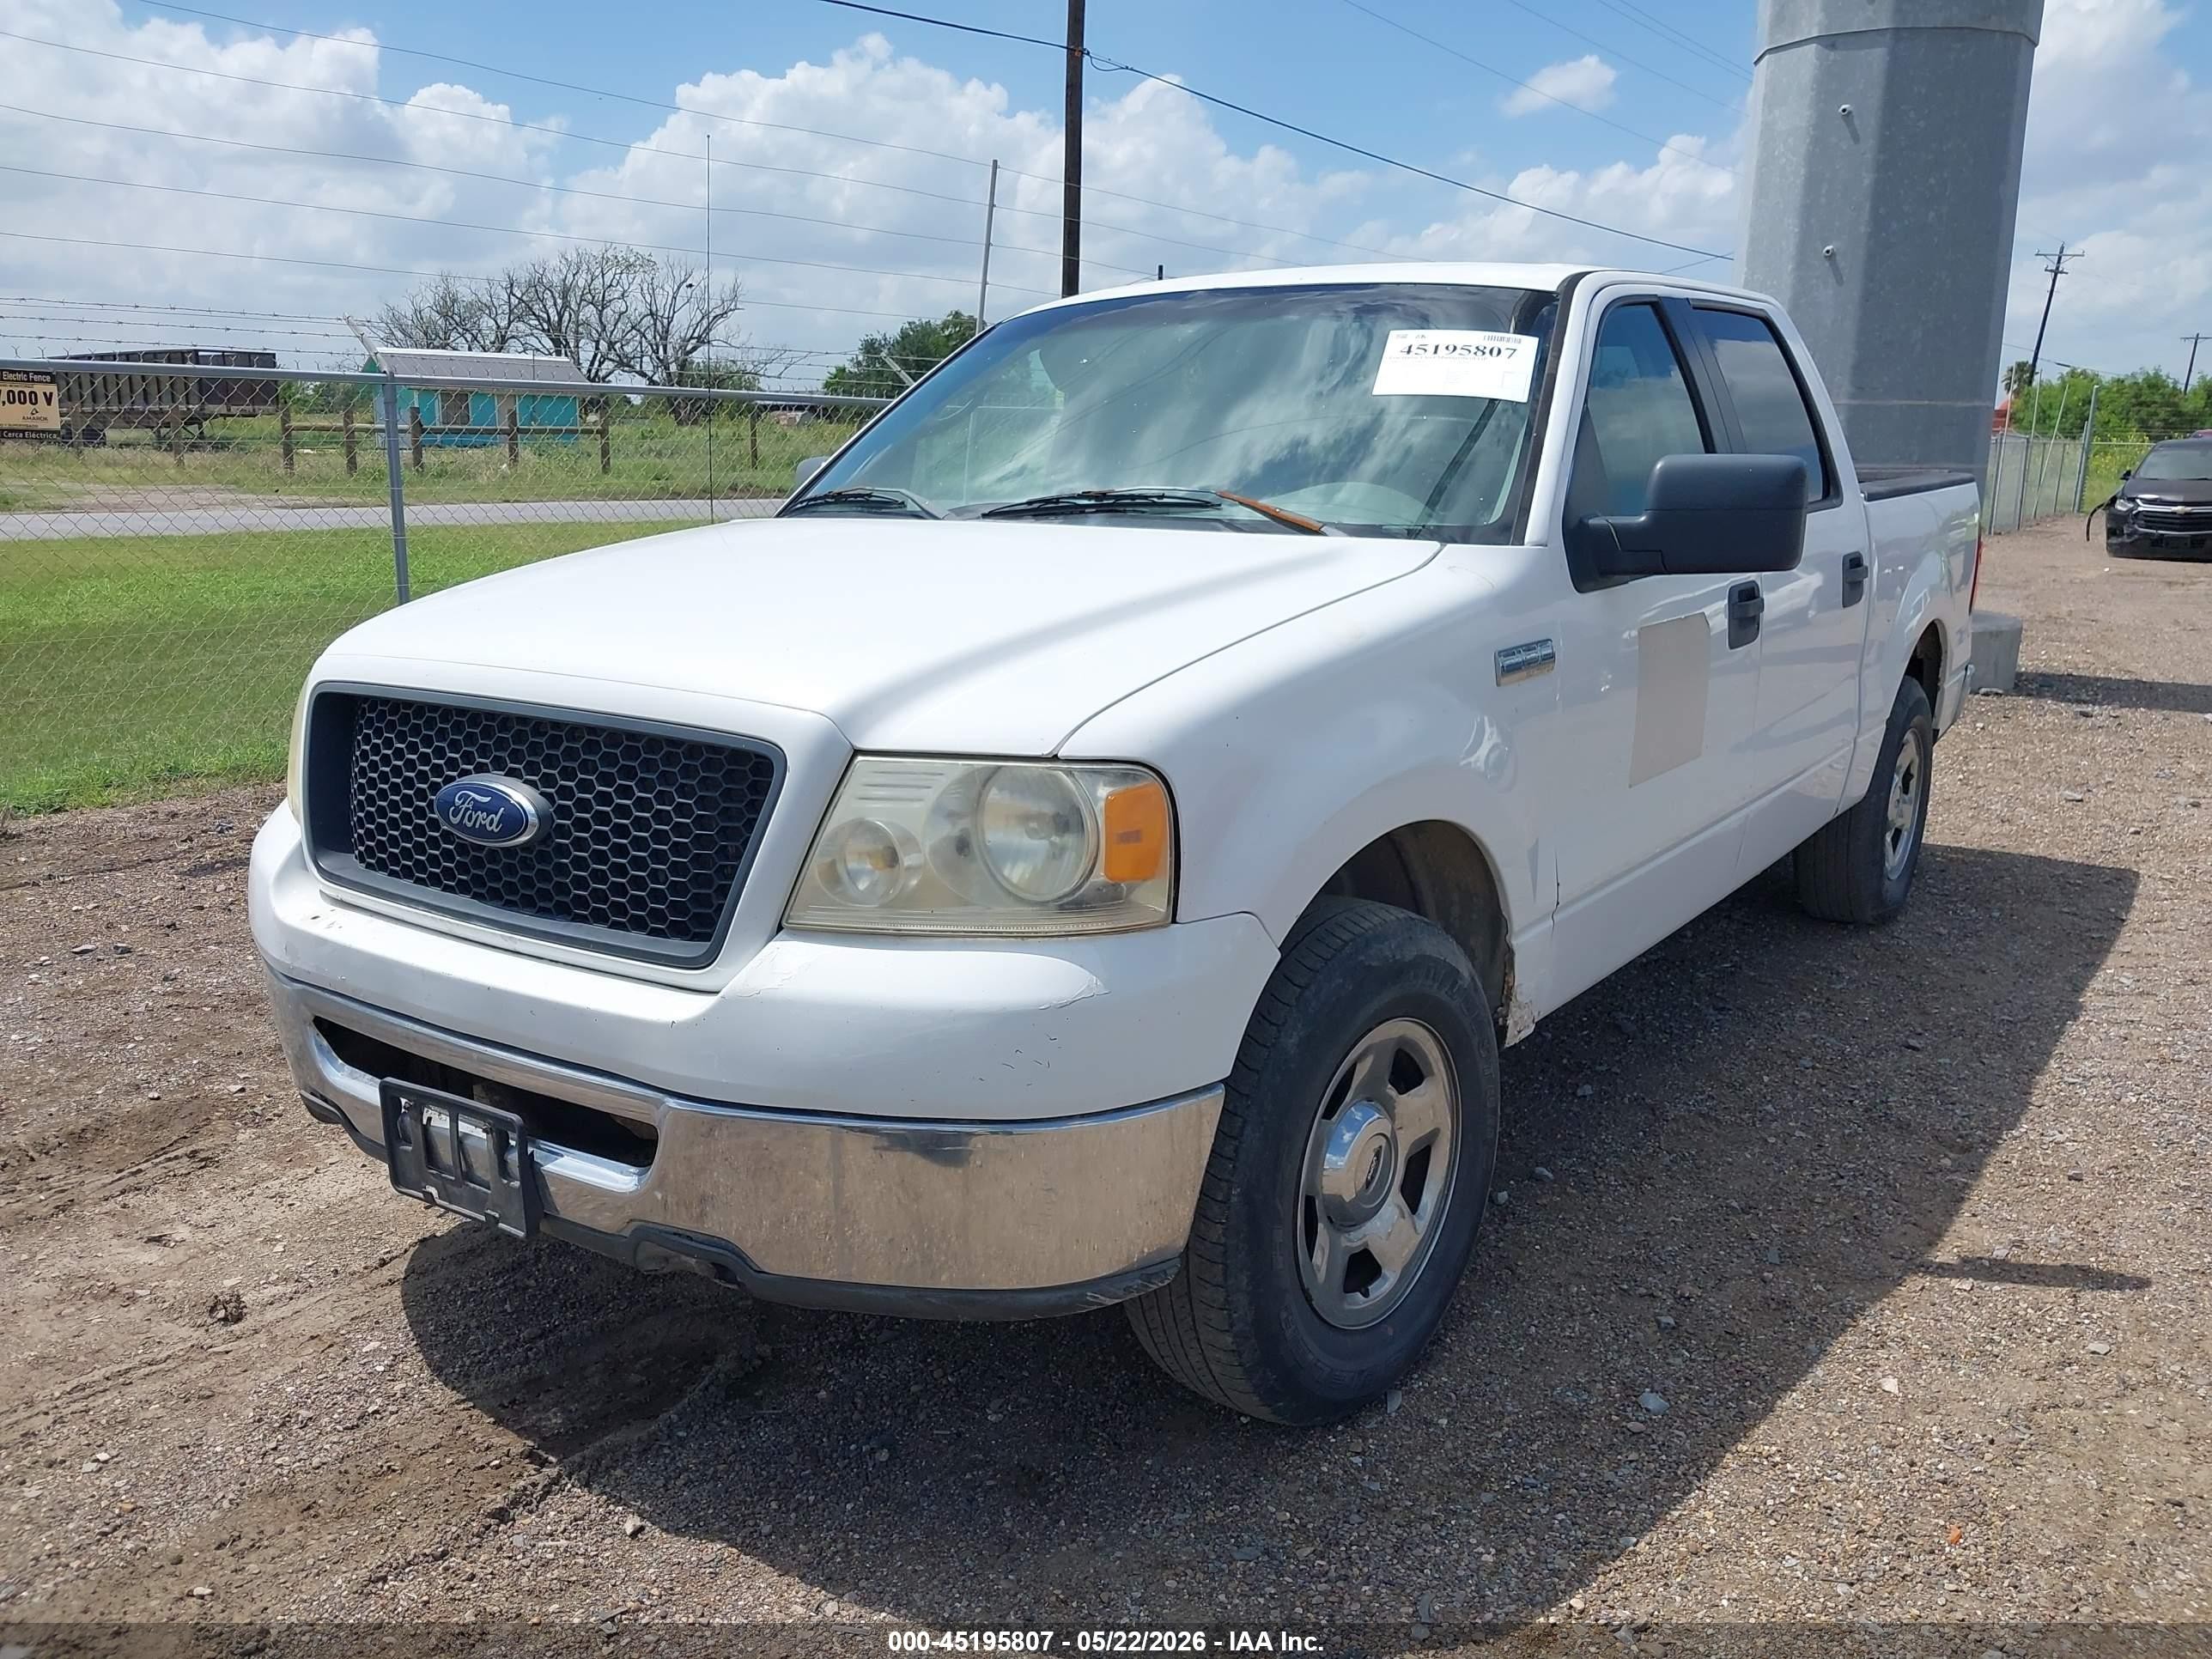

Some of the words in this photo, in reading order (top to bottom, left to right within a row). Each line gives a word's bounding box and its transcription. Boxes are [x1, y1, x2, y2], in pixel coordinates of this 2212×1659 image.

[1400, 343, 1518, 360] 45195807
[3, 371, 27, 382] Electric
[29, 372, 52, 383] Fence
[0, 389, 39, 406] ,000
[43, 391, 54, 406] V
[448, 790, 506, 833] Ford
